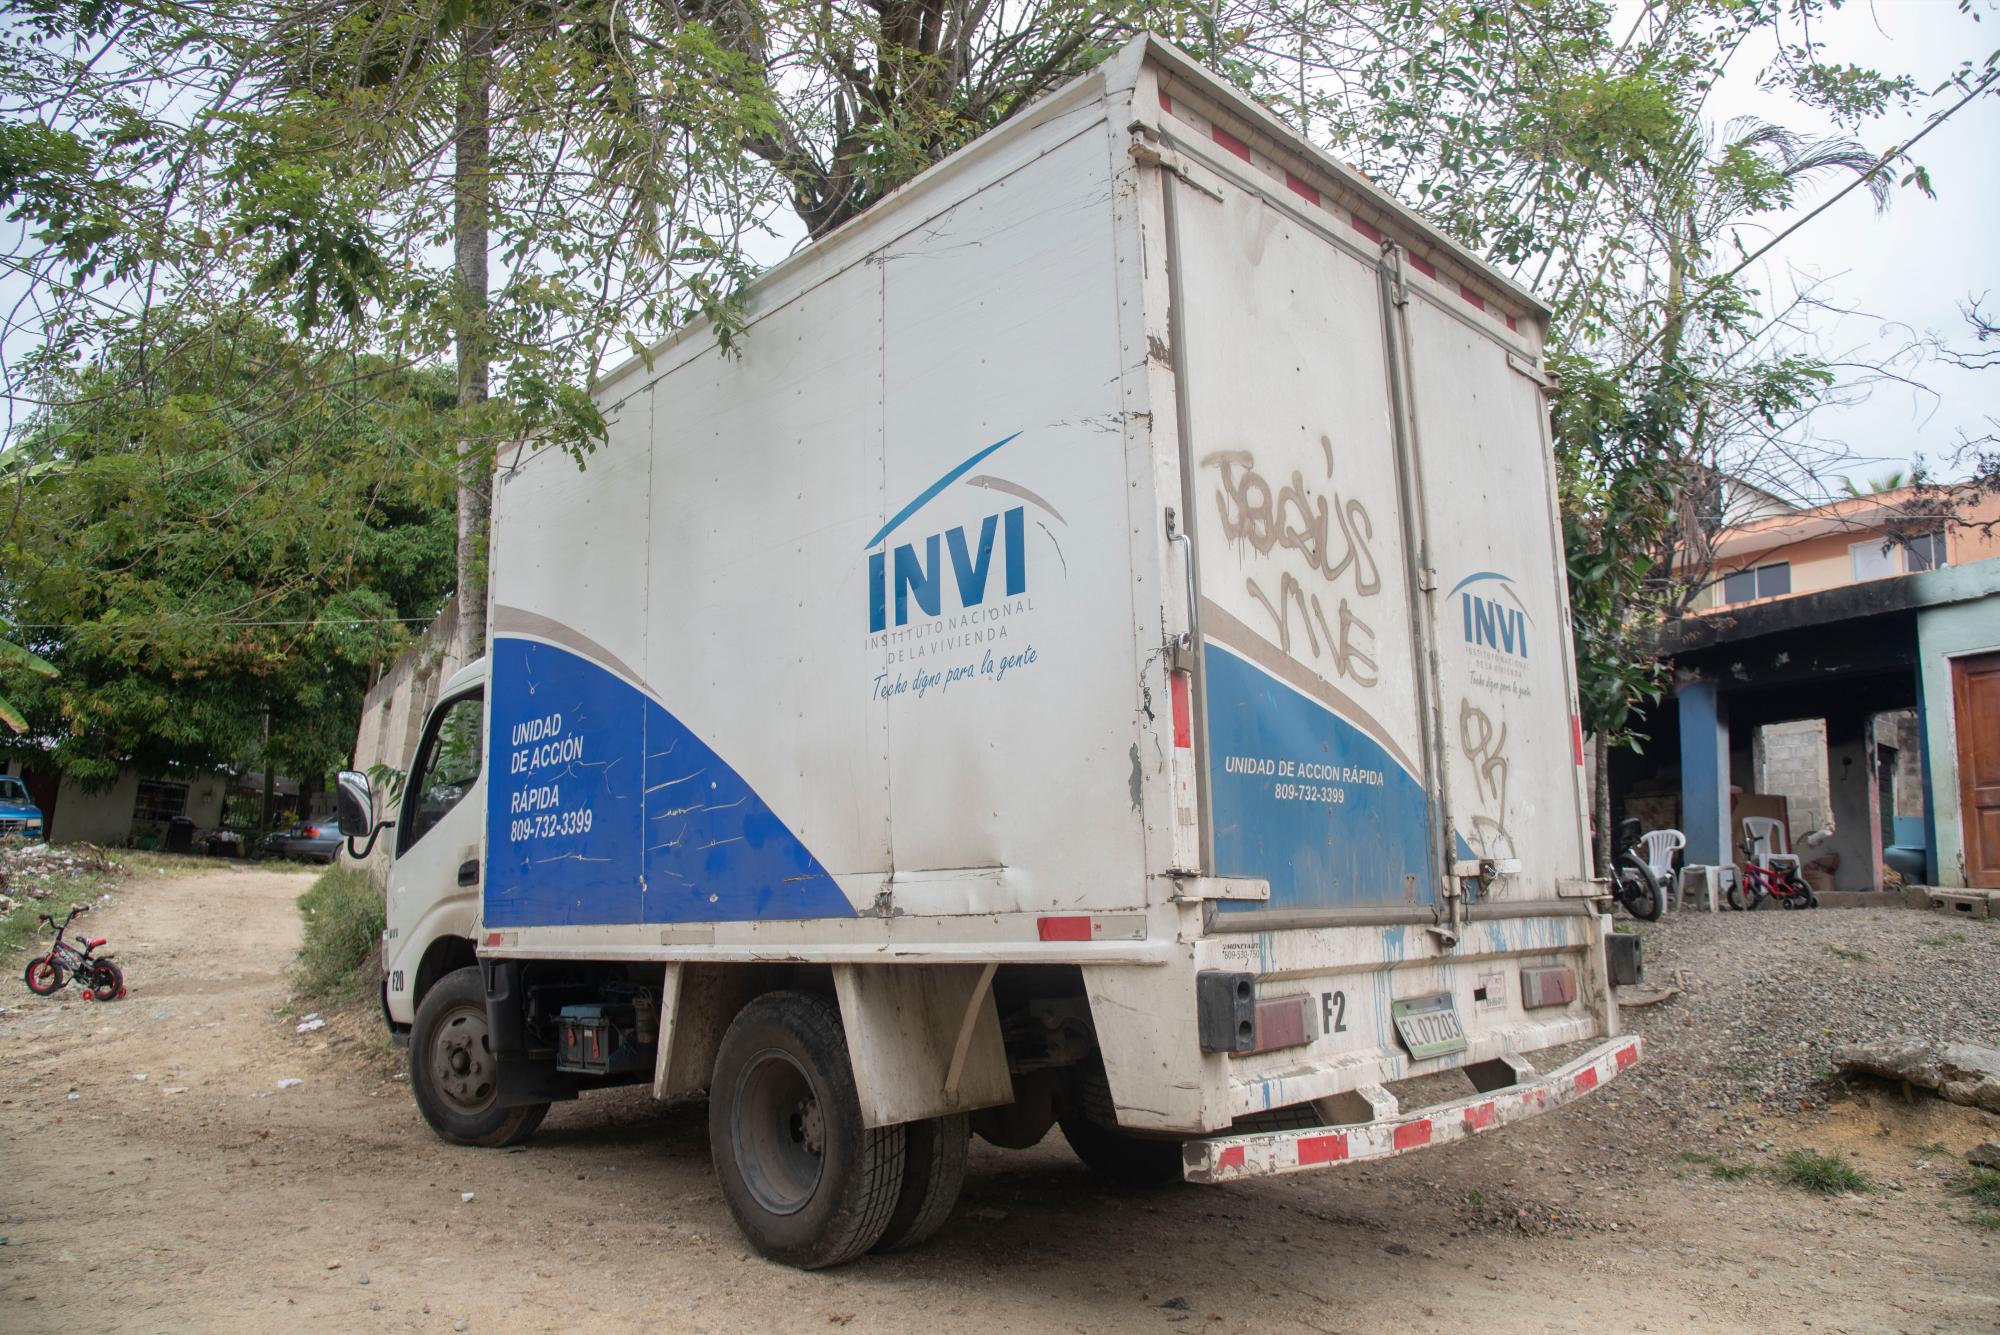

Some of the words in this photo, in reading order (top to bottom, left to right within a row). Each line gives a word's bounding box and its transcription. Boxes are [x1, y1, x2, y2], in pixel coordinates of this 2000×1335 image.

[869, 506, 1025, 633] INVI
[864, 621, 943, 650] INSTITUTO
[949, 598, 1035, 631] NACIONAL
[1462, 591, 1527, 658] INVI
[888, 650, 905, 665] DE
[909, 645, 926, 660] LA
[930, 625, 1008, 656] VIVIENDA
[873, 673, 908, 701] Techo
[912, 665, 941, 699] digno
[943, 662, 974, 694] para
[980, 648, 994, 674] la
[997, 644, 1038, 681] gente
[512, 713, 562, 747] UNIDAD
[511, 749, 529, 775] DE
[530, 732, 584, 771] ACCIÓN
[1225, 756, 1275, 776] UNIDAD
[1278, 760, 1295, 777] DE
[1342, 764, 1384, 786] RÁPIDA
[511, 784, 560, 814] RÁPIDA
[1275, 783, 1345, 803] 809-732-3399
[511, 808, 592, 842] 809-732-3399
[392, 969, 404, 992] F20
[1322, 990, 1347, 1034] F2
[1400, 1012, 1461, 1046] EL07203
